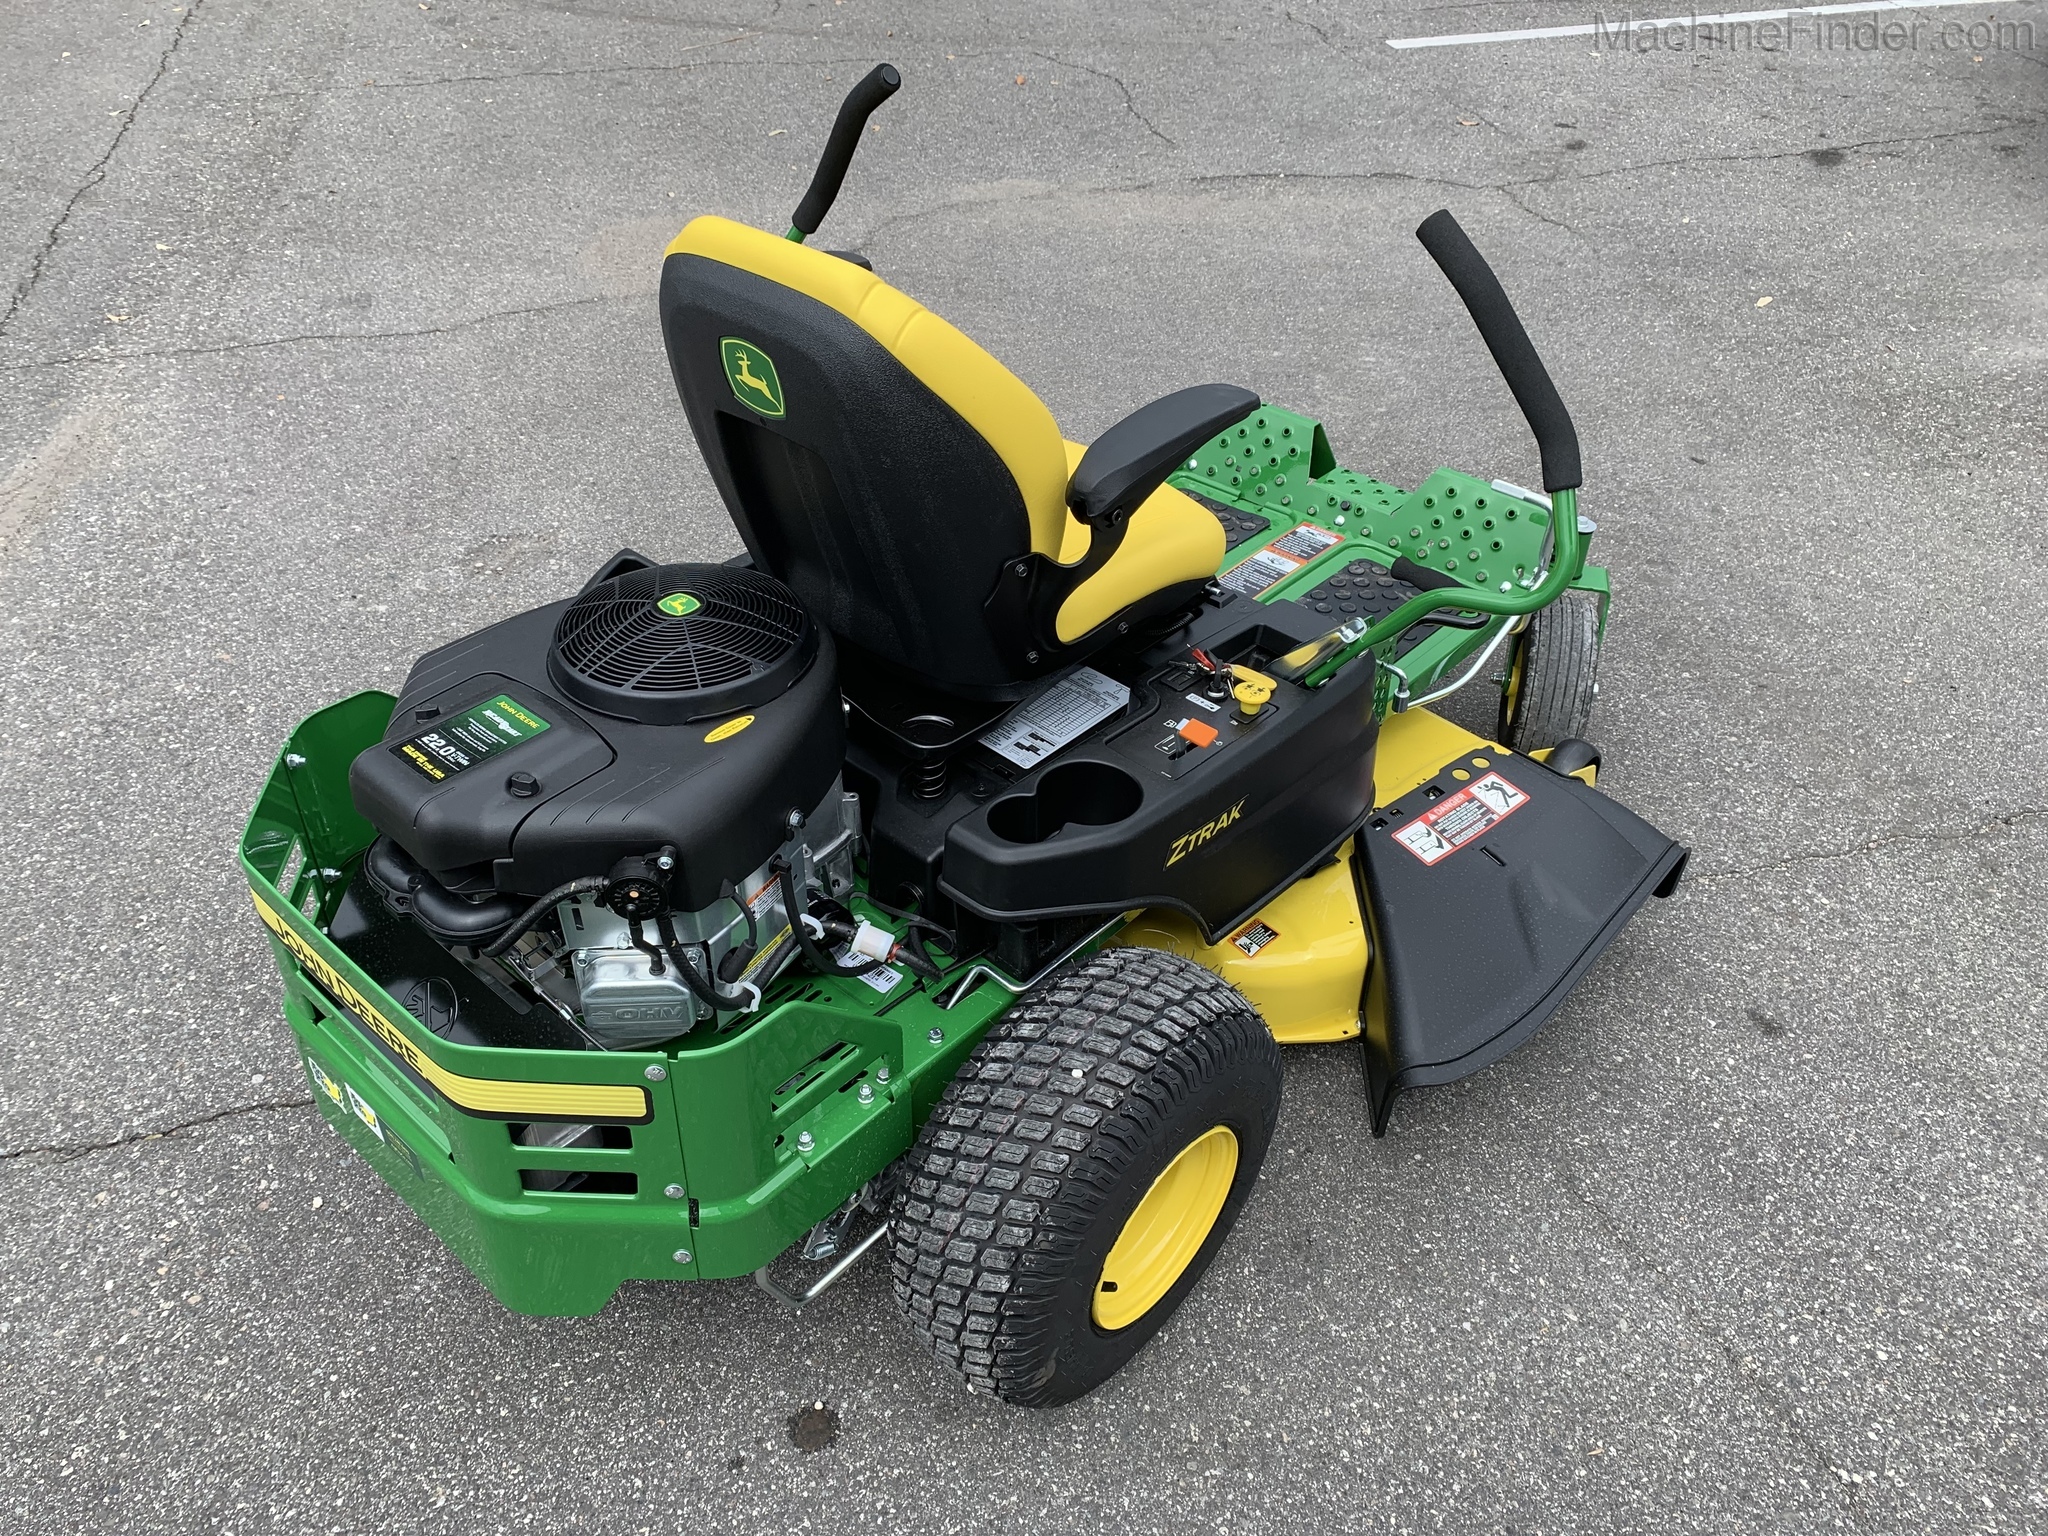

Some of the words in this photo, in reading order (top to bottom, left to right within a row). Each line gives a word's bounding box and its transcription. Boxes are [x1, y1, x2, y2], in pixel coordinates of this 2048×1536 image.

[496, 700, 518, 715] JOHN
[515, 712, 540, 729] DEERE
[420, 732, 455, 756] 22.0
[1434, 793, 1467, 815] DANGER
[1166, 799, 1246, 867] ZTRAK
[275, 918, 334, 991] JOHN
[336, 975, 423, 1073] DEERE
